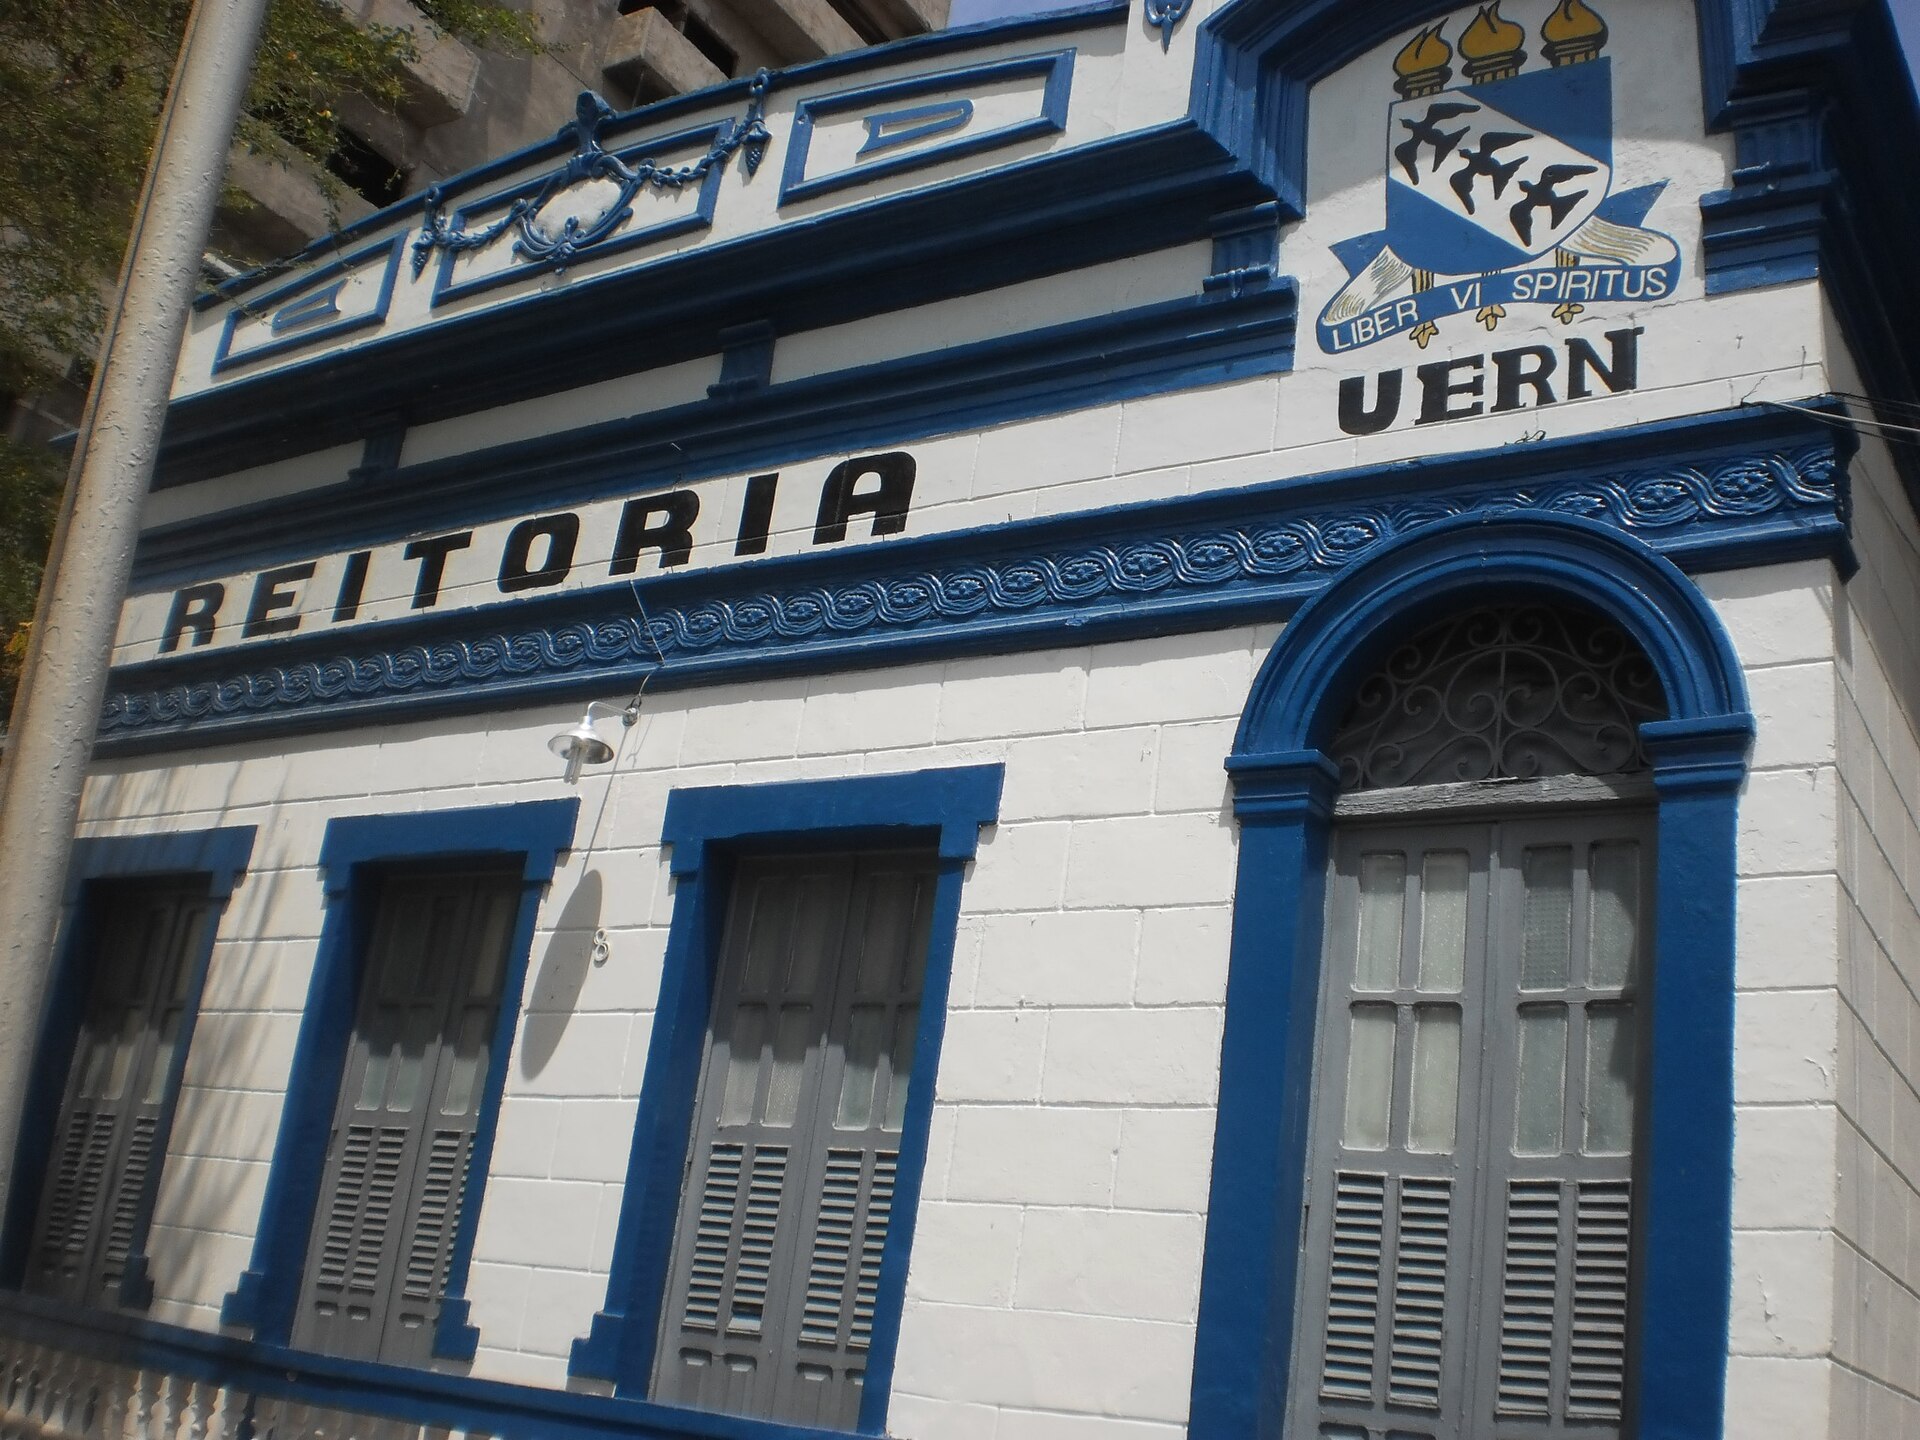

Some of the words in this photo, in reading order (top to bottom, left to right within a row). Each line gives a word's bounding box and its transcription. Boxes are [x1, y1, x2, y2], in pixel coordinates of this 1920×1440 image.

[1332, 299, 1419, 351] LIBER
[1450, 282, 1482, 310] VI
[1512, 267, 1667, 300] SPIRITUS
[1338, 327, 1644, 435] UERN
[159, 451, 917, 654] REITORIA
